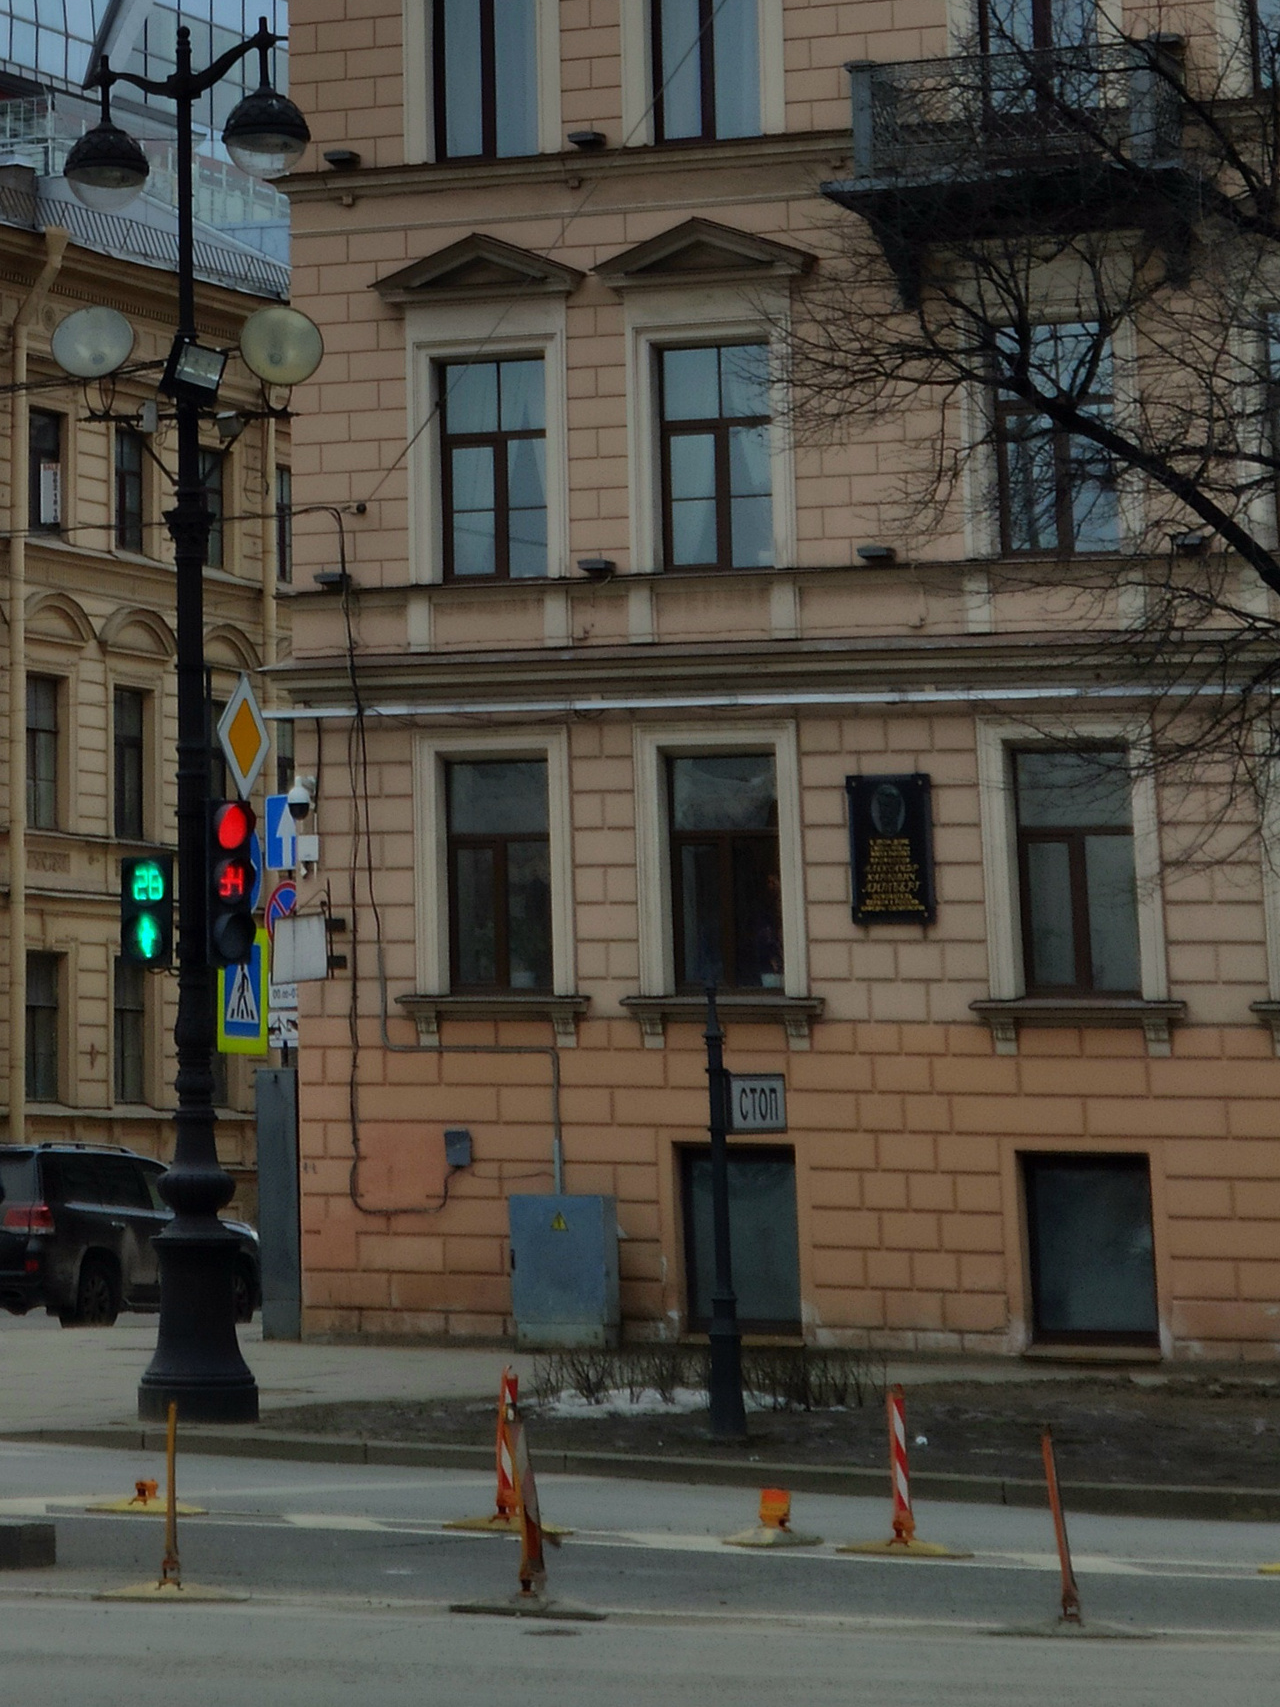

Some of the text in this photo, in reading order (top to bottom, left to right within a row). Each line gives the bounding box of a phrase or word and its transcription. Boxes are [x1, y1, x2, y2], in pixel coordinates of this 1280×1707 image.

[133, 864, 164, 901] 28
[219, 864, 244, 897] 34
[740, 1087, 779, 1121] СТОП
